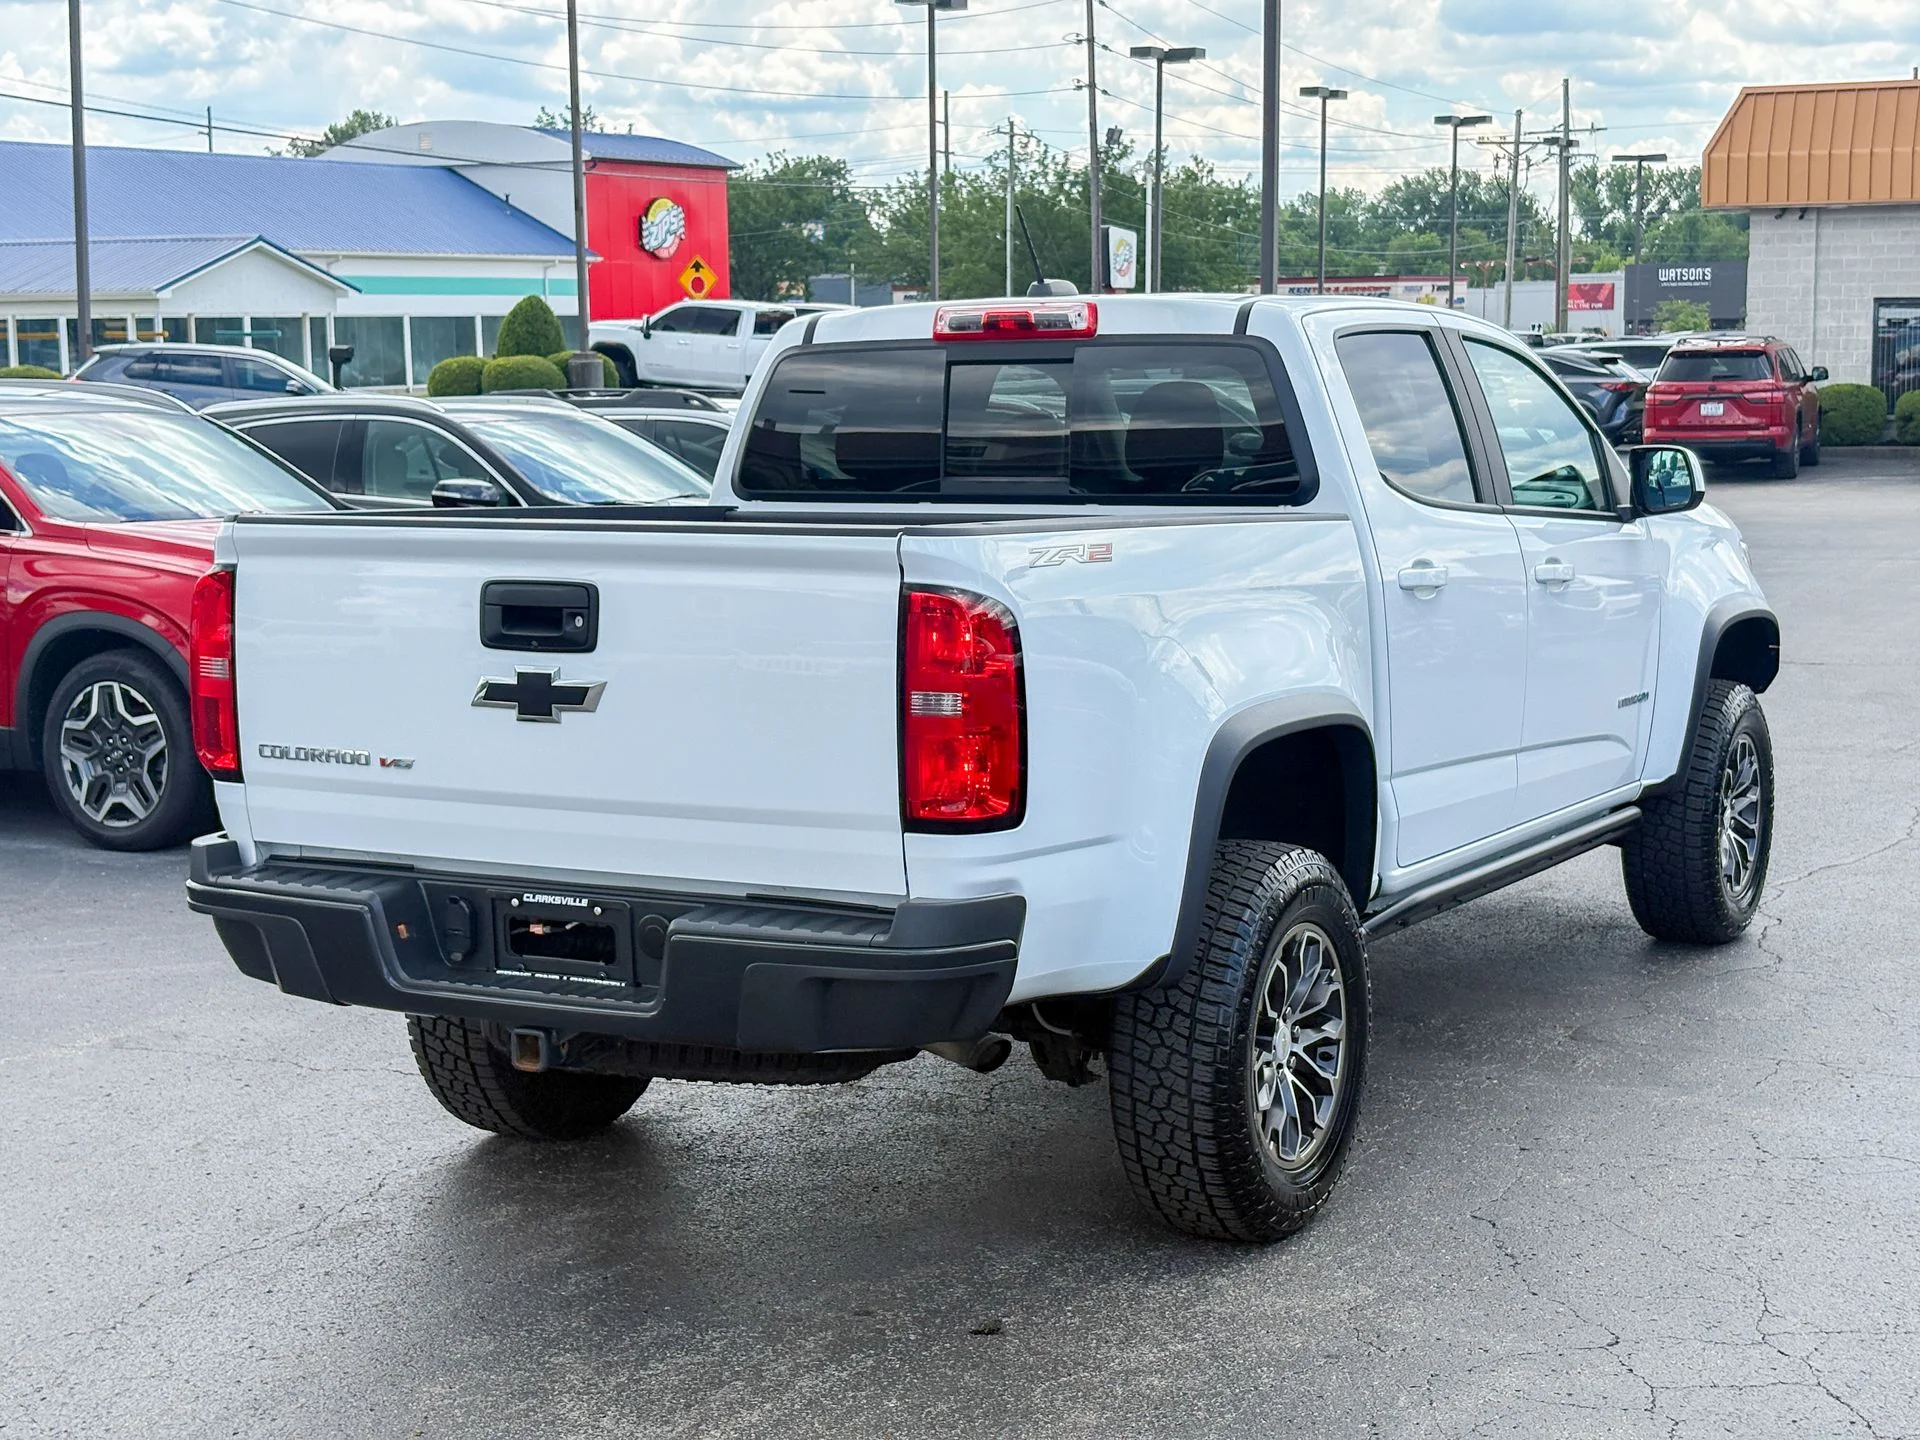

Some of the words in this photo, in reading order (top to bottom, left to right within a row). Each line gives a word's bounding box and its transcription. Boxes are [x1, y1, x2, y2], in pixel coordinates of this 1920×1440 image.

[1658, 267, 1712, 282] WATSON'S
[1028, 543, 1113, 568] ZR2
[258, 744, 371, 766] COLORADO
[523, 893, 588, 907] CLARKSVILLE
